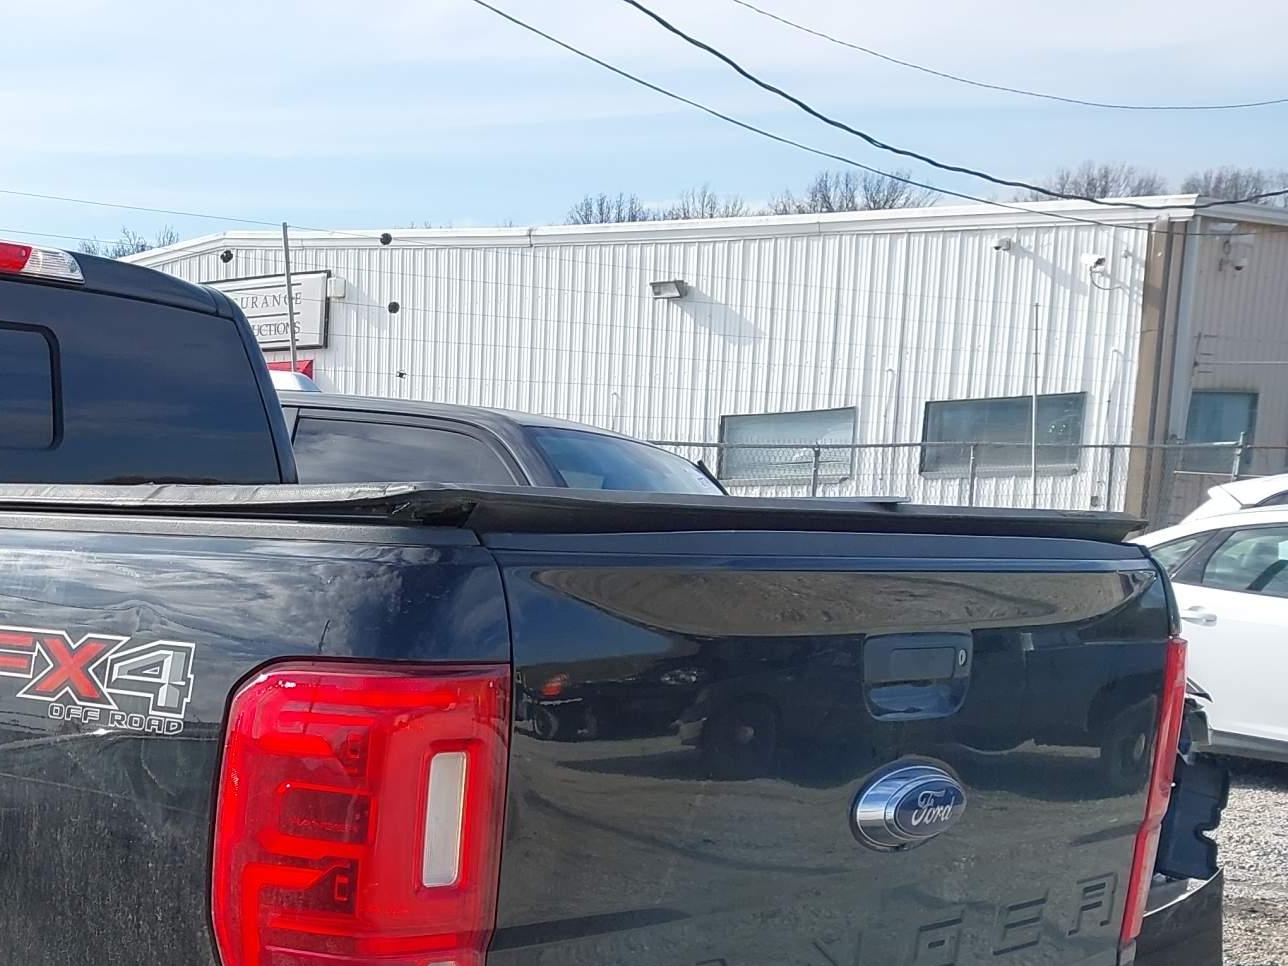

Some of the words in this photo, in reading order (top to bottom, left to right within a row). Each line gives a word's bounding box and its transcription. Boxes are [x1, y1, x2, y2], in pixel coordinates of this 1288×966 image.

[48, 703, 101, 724] OFF
[108, 710, 184, 735] ROAD
[911, 789, 956, 827] Ford
